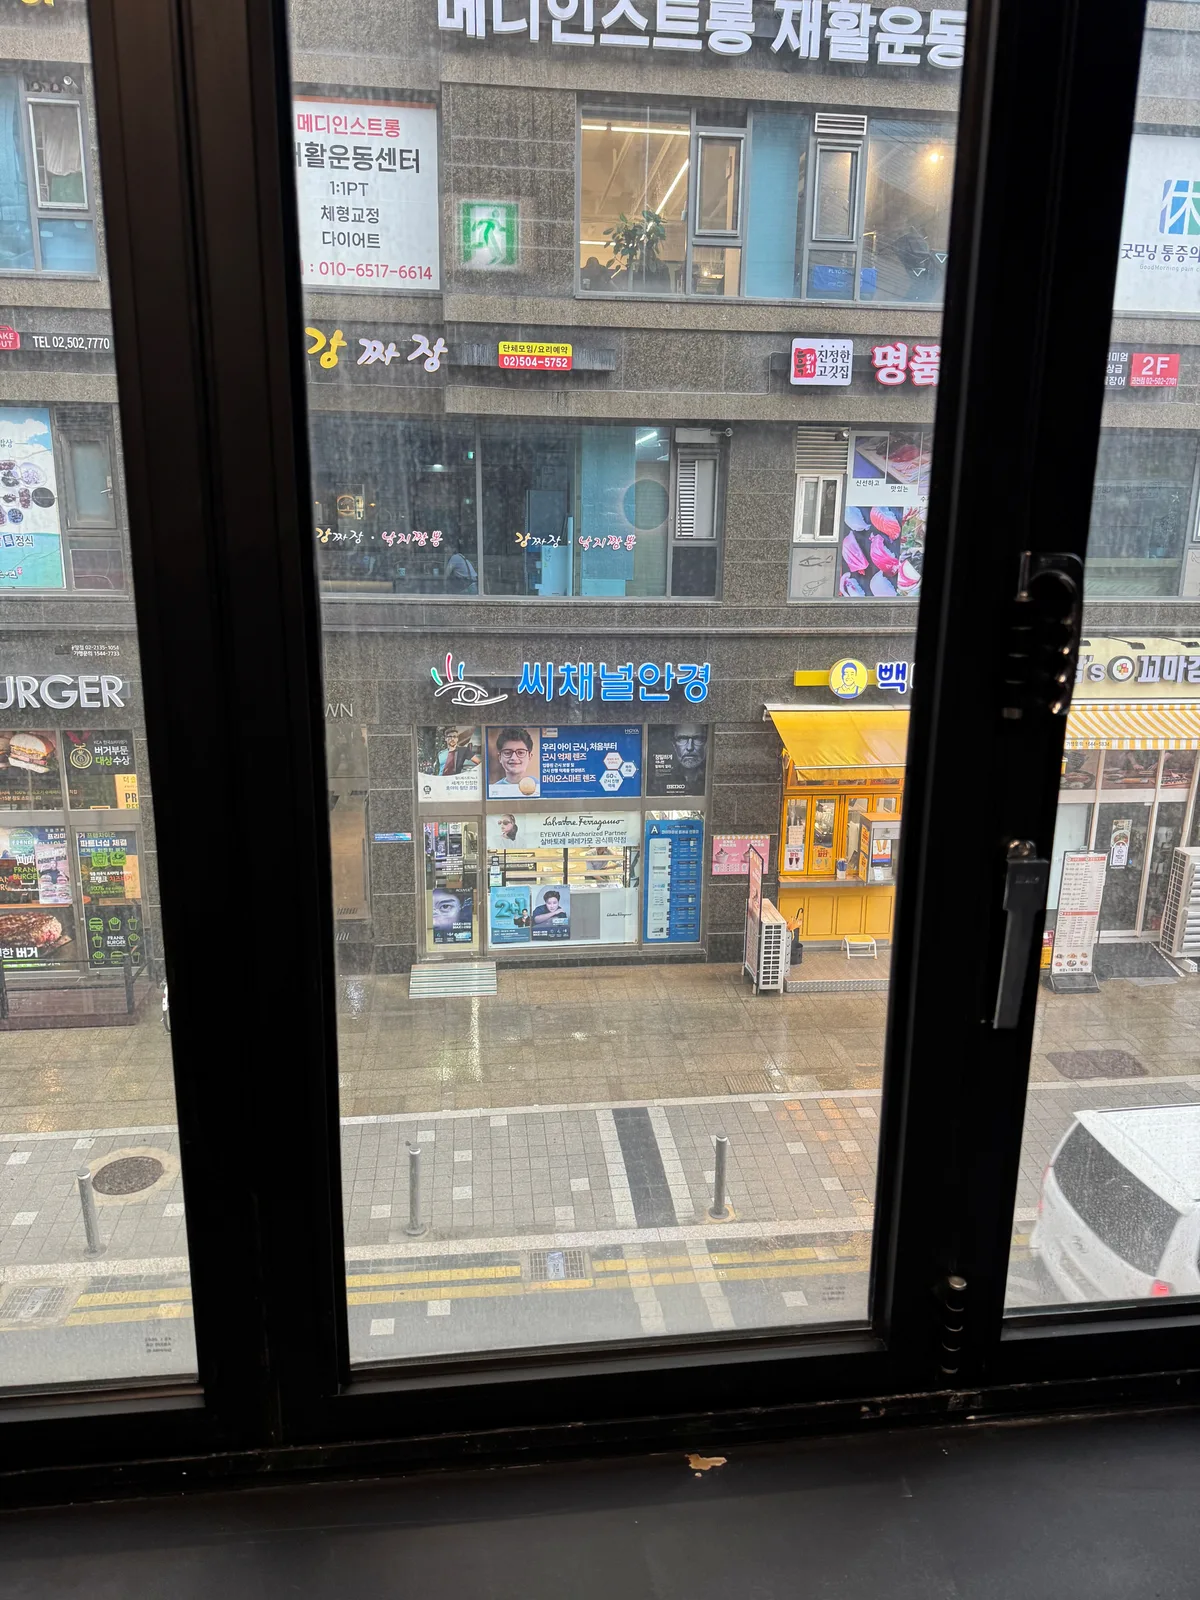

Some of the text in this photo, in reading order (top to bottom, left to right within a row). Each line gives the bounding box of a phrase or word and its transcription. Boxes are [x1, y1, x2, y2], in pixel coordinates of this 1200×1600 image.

[437, 0, 757, 56] 메디인스트롱
[297, 113, 401, 138] 메디인스트롱
[329, 180, 369, 197] 1:1PT
[320, 205, 380, 224] 체형교정
[321, 230, 381, 249] 다이어트
[1121, 243, 1158, 261] 굿모닝
[318, 261, 433, 280] 010-6517-6614
[33, 335, 110, 350] TEL 02.502.7770
[502, 344, 569, 355] 단체모임/요리예약
[503, 355, 568, 368] 02)504-5752
[816, 349, 851, 364] 진정한
[816, 365, 849, 379] 고깃집
[871, 342, 941, 387] 명품
[1141, 355, 1171, 376] 2F
[1104, 376, 1126, 386] 장어
[890, 485, 909, 493] 맛있는
[517, 661, 711, 703] 씨채널안경
[94, 745, 129, 756] 버거부문
[542, 742, 556, 751] 우리
[557, 742, 572, 751] 아이
[589, 742, 618, 751] 처음부터
[542, 753, 557, 761] 근시
[573, 752, 588, 761] 렌즈
[542, 774, 597, 783] 마이오스마트 렌즈
[542, 815, 625, 831] Salvatore Ferragamo
[540, 838, 567, 846] 살바토레
[15, 946, 39, 958] 버거
